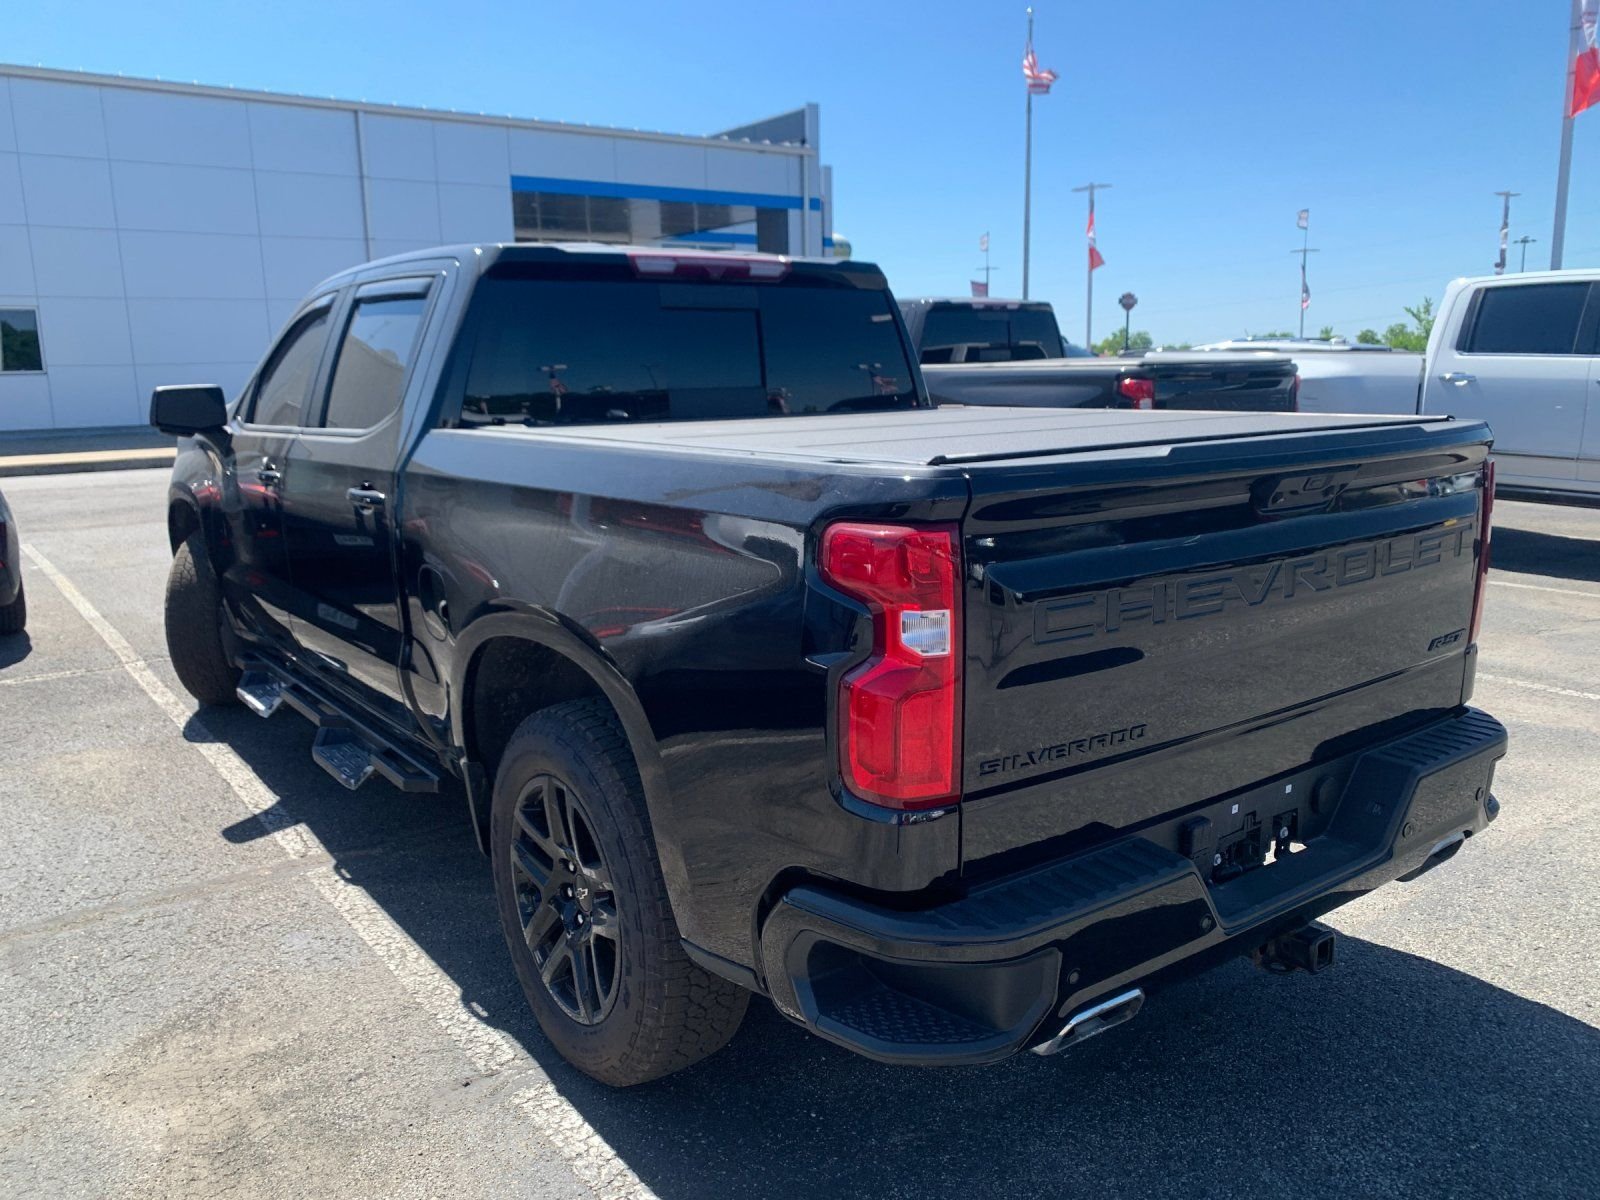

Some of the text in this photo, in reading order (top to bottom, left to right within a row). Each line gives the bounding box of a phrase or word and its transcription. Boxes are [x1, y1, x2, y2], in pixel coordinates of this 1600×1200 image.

[1032, 523, 1473, 644] CHEVROLET
[1428, 628, 1466, 651] RST
[979, 723, 1147, 776] SILVERADO
